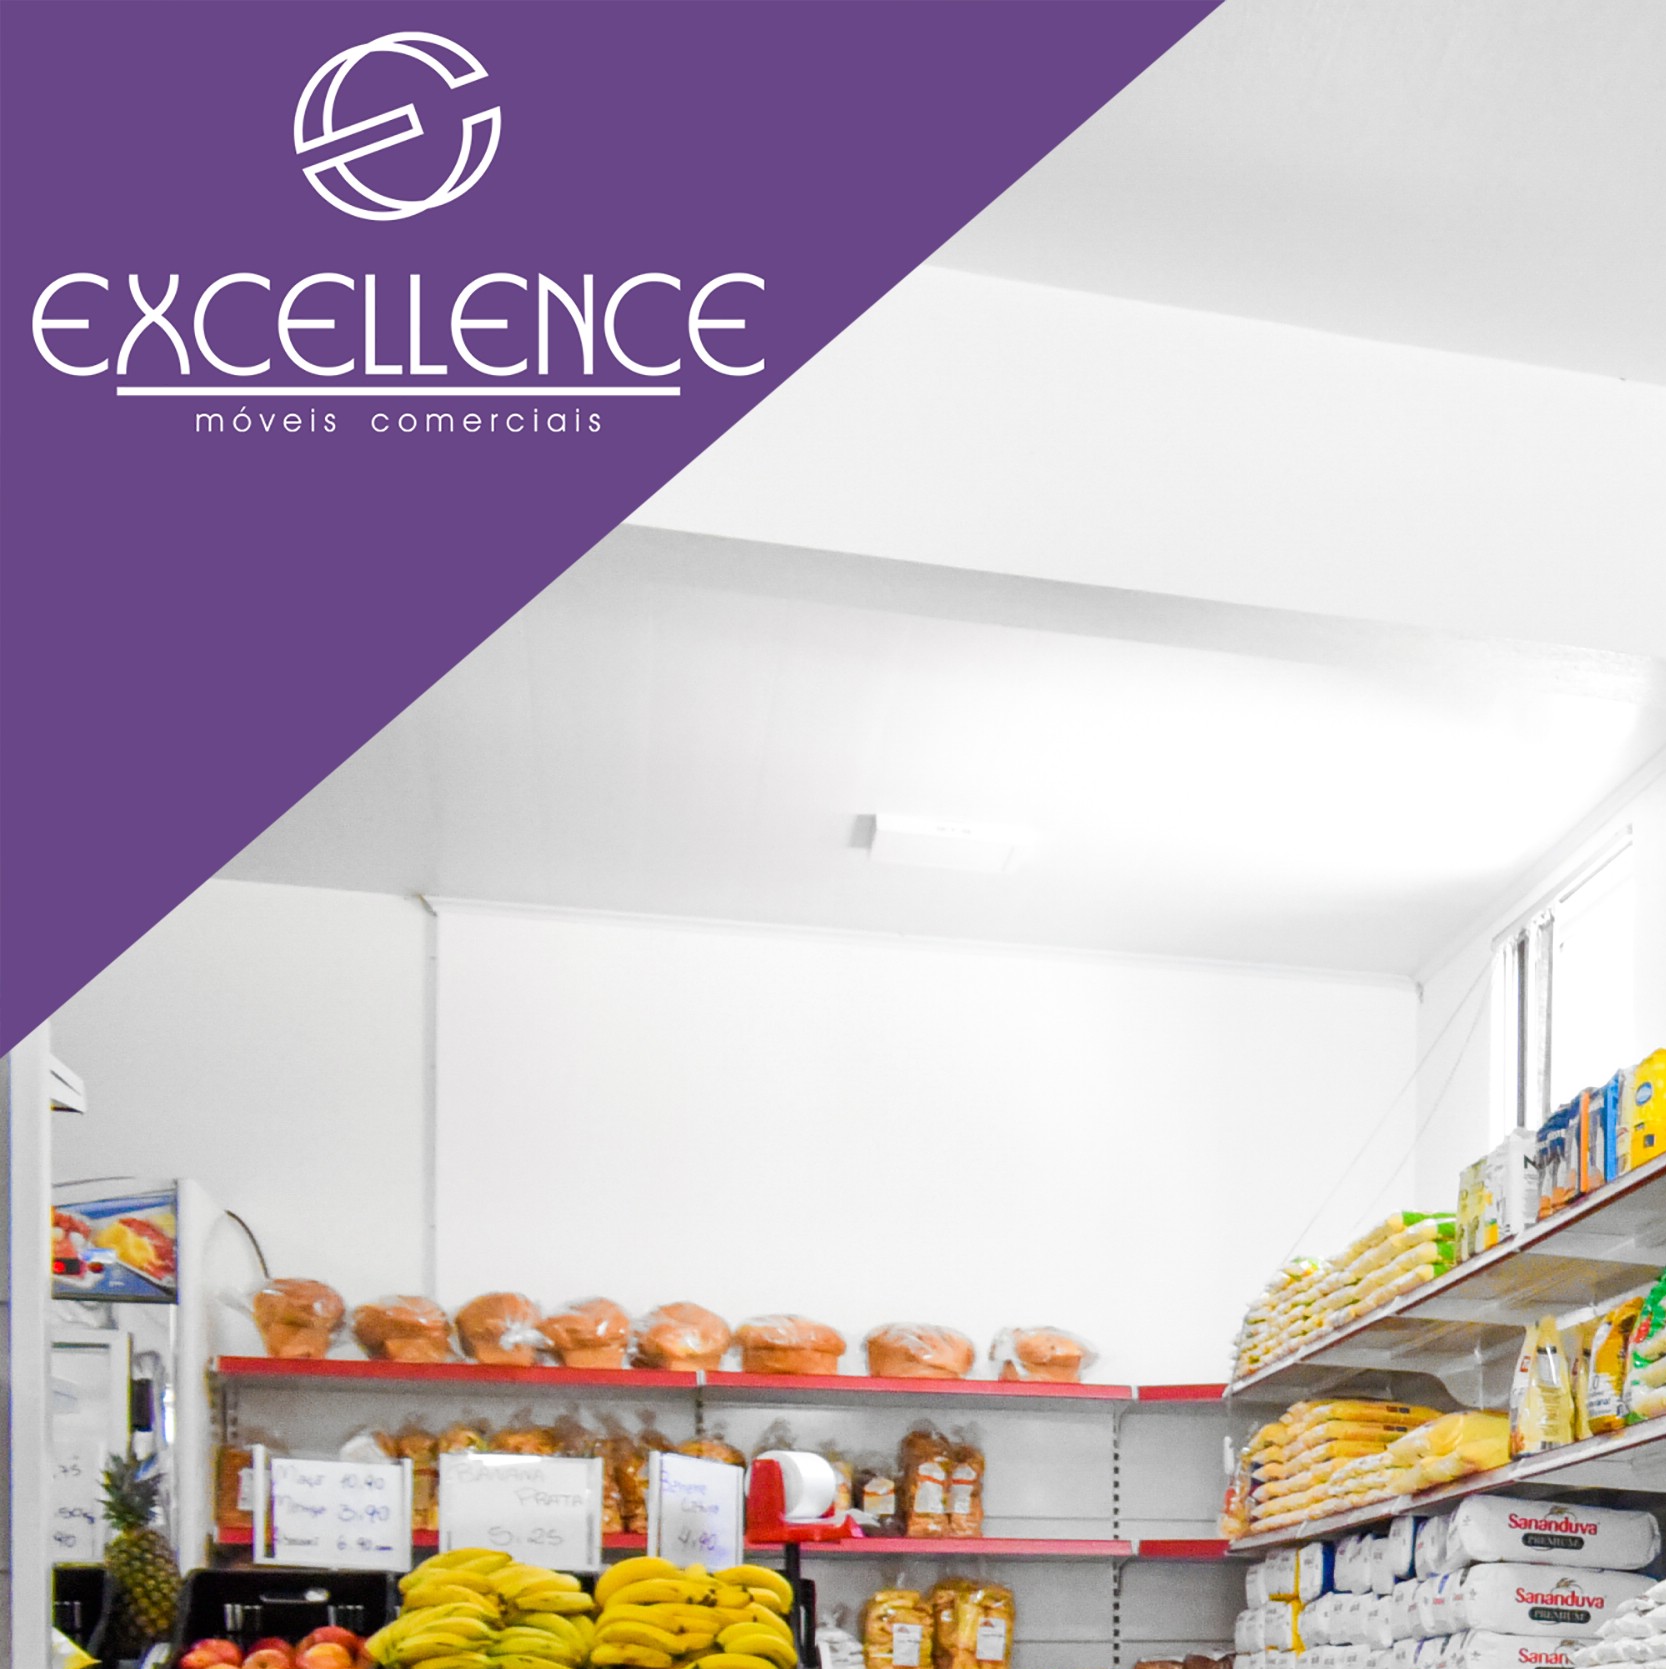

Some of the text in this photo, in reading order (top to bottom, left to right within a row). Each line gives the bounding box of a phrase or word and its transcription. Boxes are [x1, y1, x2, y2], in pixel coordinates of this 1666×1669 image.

[1508, 1512, 1598, 1536] Sananduva
[1527, 1534, 1580, 1548] PREMIUM
[1515, 1587, 1605, 1610] Sananduva
[1533, 1608, 1586, 1622] PREMIUM
[1518, 1647, 1571, 1665] Sanan
